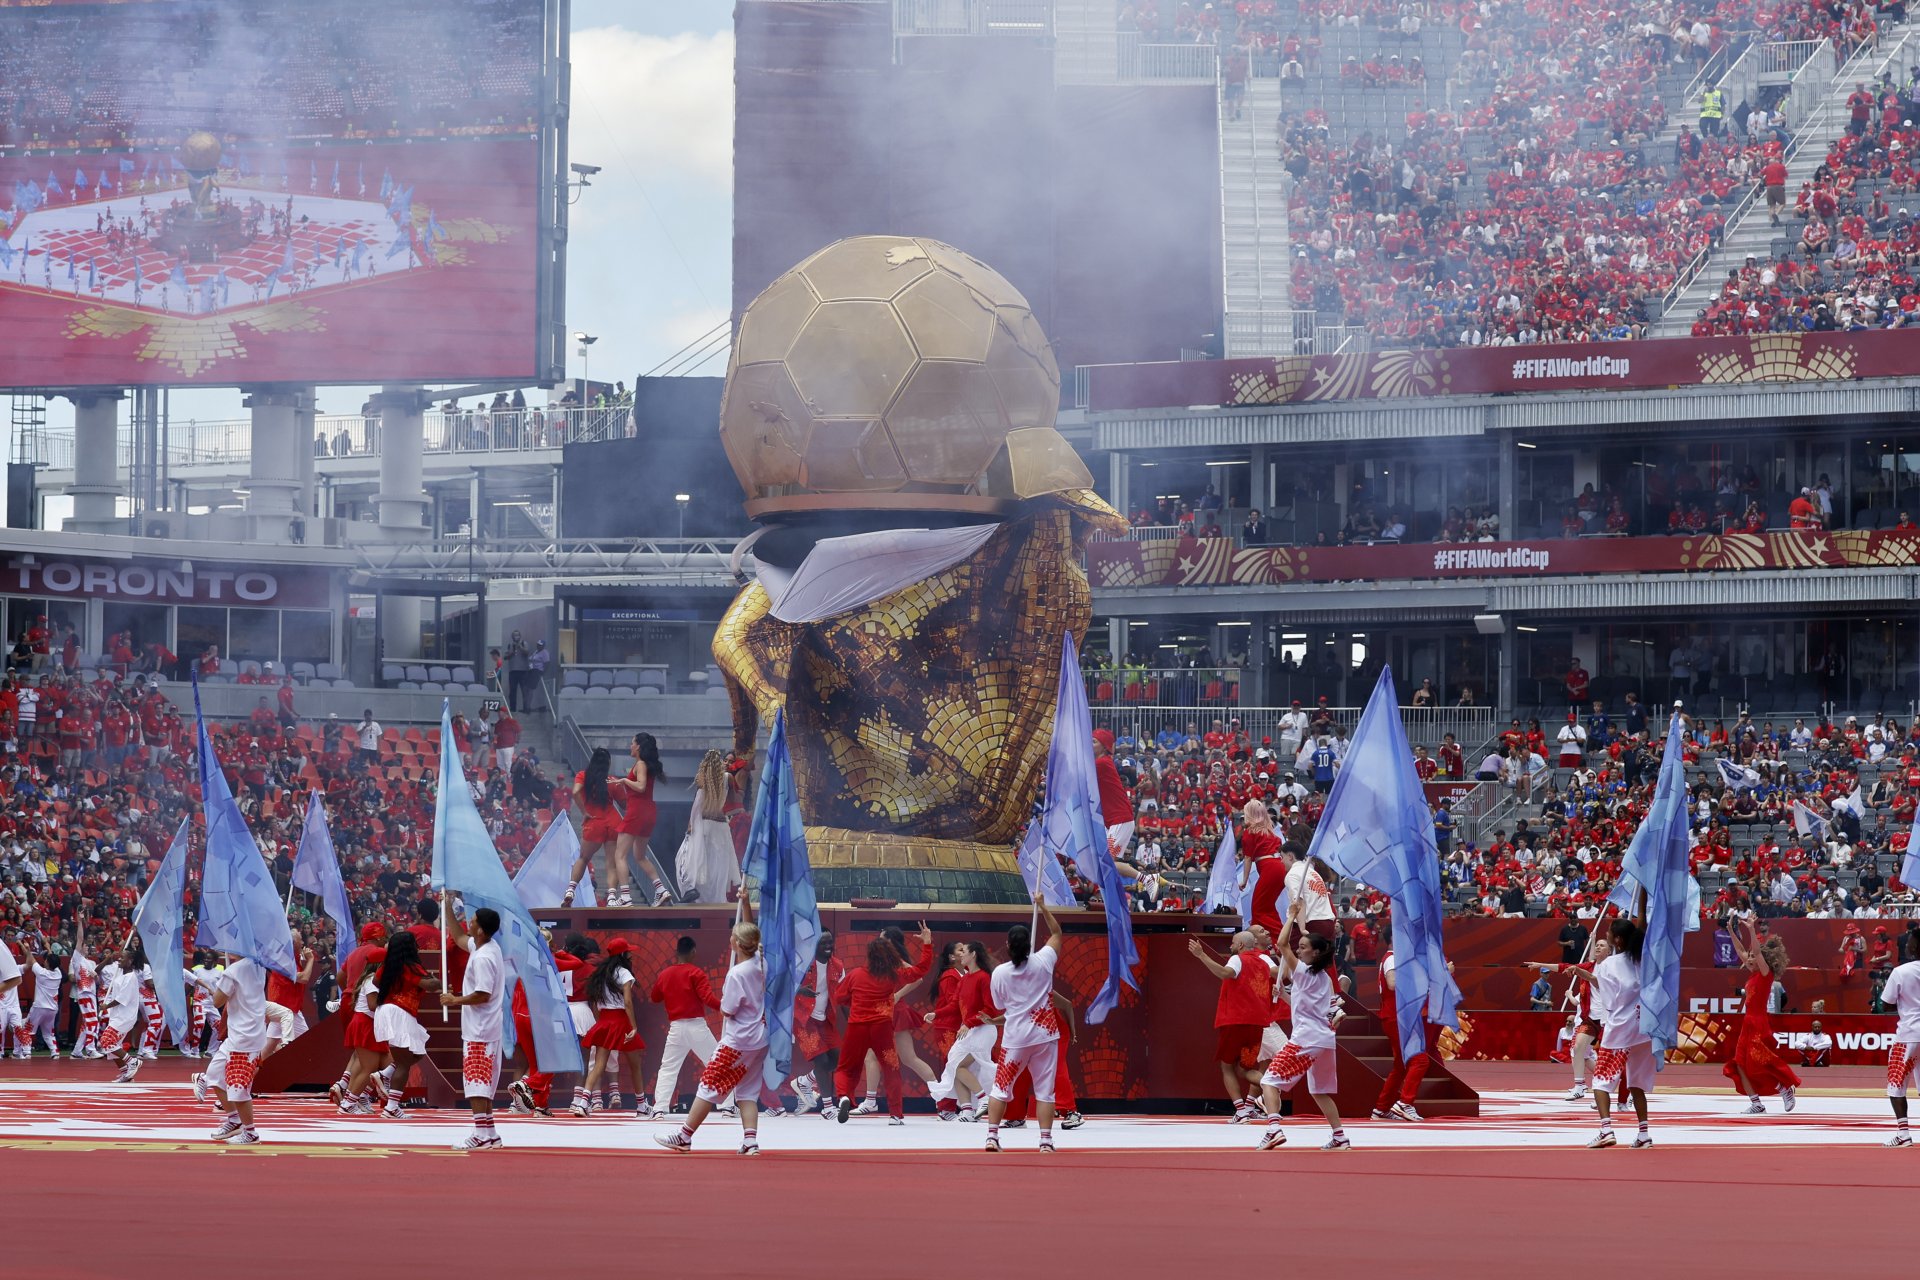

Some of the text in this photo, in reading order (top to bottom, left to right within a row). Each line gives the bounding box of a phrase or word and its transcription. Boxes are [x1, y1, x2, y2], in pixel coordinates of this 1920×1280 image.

[1513, 356, 1630, 379] #FIFAWorldCup
[1434, 548, 1549, 570] #FIFAWorldCup
[8, 560, 278, 601] TORONTO
[485, 701, 500, 710] 127
[1318, 753, 1329, 767] 10
[1451, 788, 1467, 796] FIFA
[1690, 998, 1746, 1013] FIF
